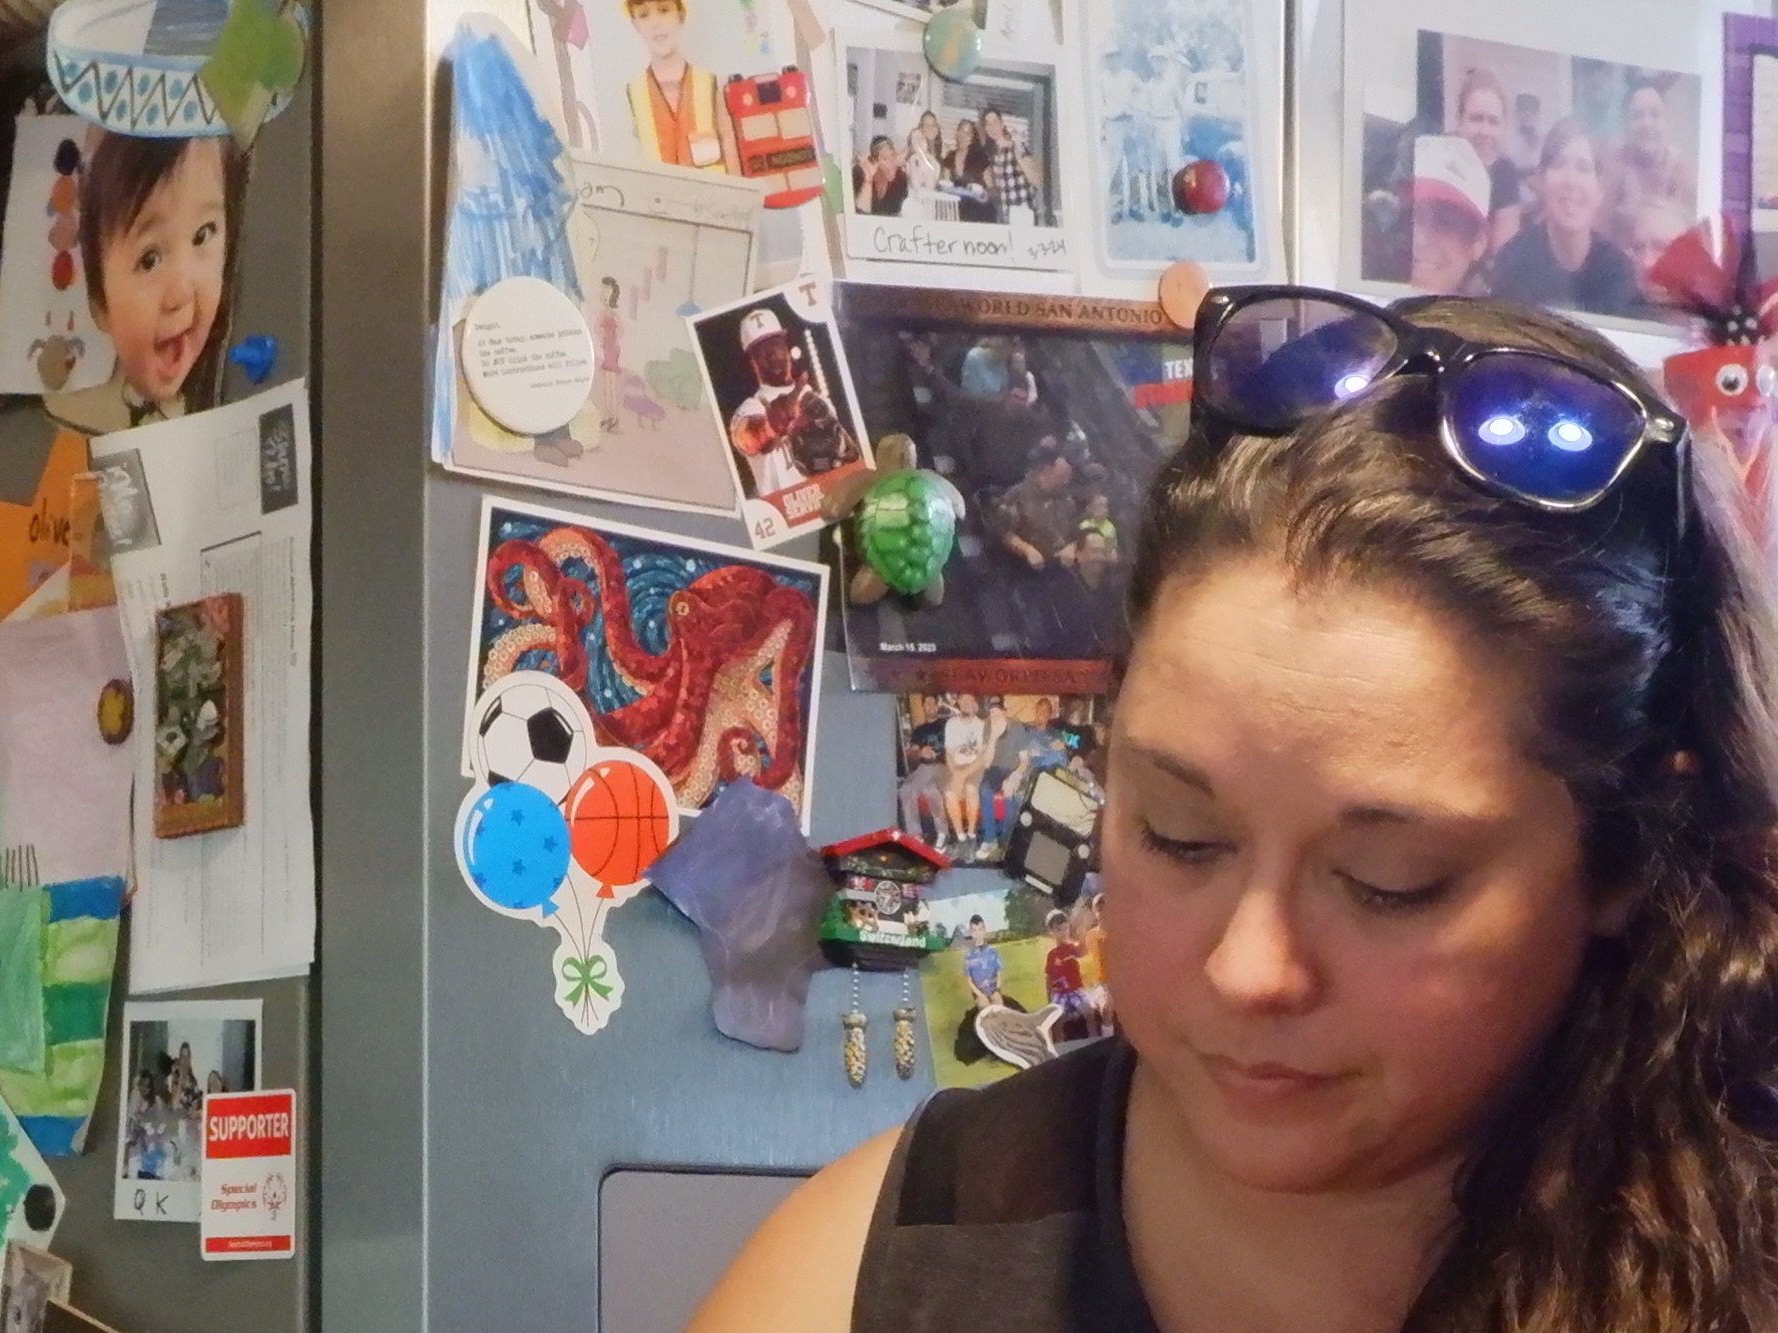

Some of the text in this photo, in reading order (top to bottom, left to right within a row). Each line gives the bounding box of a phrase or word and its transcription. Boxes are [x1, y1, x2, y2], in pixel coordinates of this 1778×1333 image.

[798, 281, 818, 306] T
[1038, 299, 1071, 318] SAN
[1078, 303, 1162, 325] ANTONIO
[1165, 361, 1194, 380] TEX
[754, 518, 776, 540] 42
[859, 928, 927, 949] Switzerland
[209, 1113, 290, 1141] SUPPORTER
[221, 1182, 257, 1197] Special
[211, 1199, 257, 1213] Olympics
